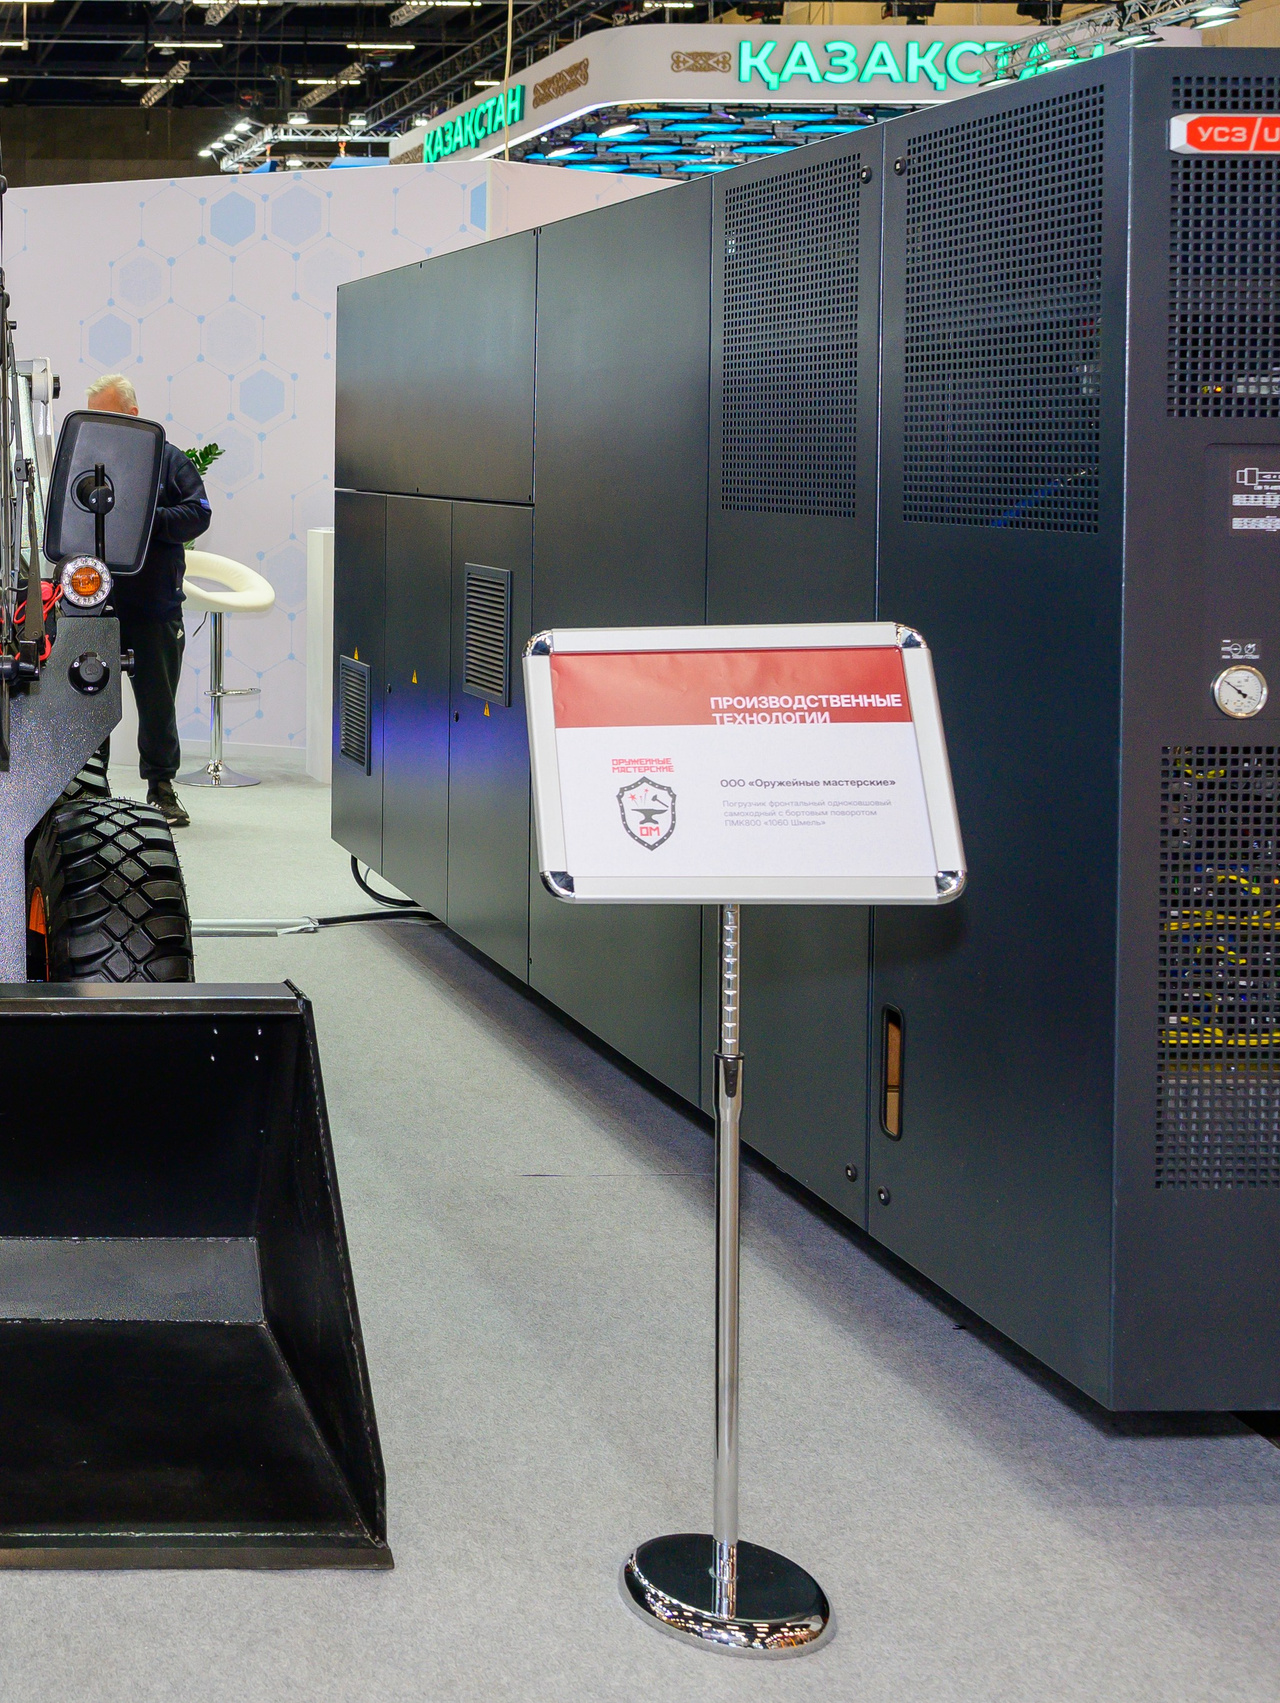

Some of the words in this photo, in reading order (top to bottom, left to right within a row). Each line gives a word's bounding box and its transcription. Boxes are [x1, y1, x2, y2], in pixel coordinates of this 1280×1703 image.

[709, 694, 903, 710] ПРОИЗВОДСТВЕННЫЕ
[711, 711, 832, 725] ТЕХНОЛОГИИ
[720, 779, 746, 788] ООО
[748, 778, 821, 789] «Оружейные
[822, 780, 896, 788] мастерские»
[722, 800, 767, 808] Погрузчик
[768, 799, 825, 808] фронтальный
[723, 809, 776, 818] самоходный
